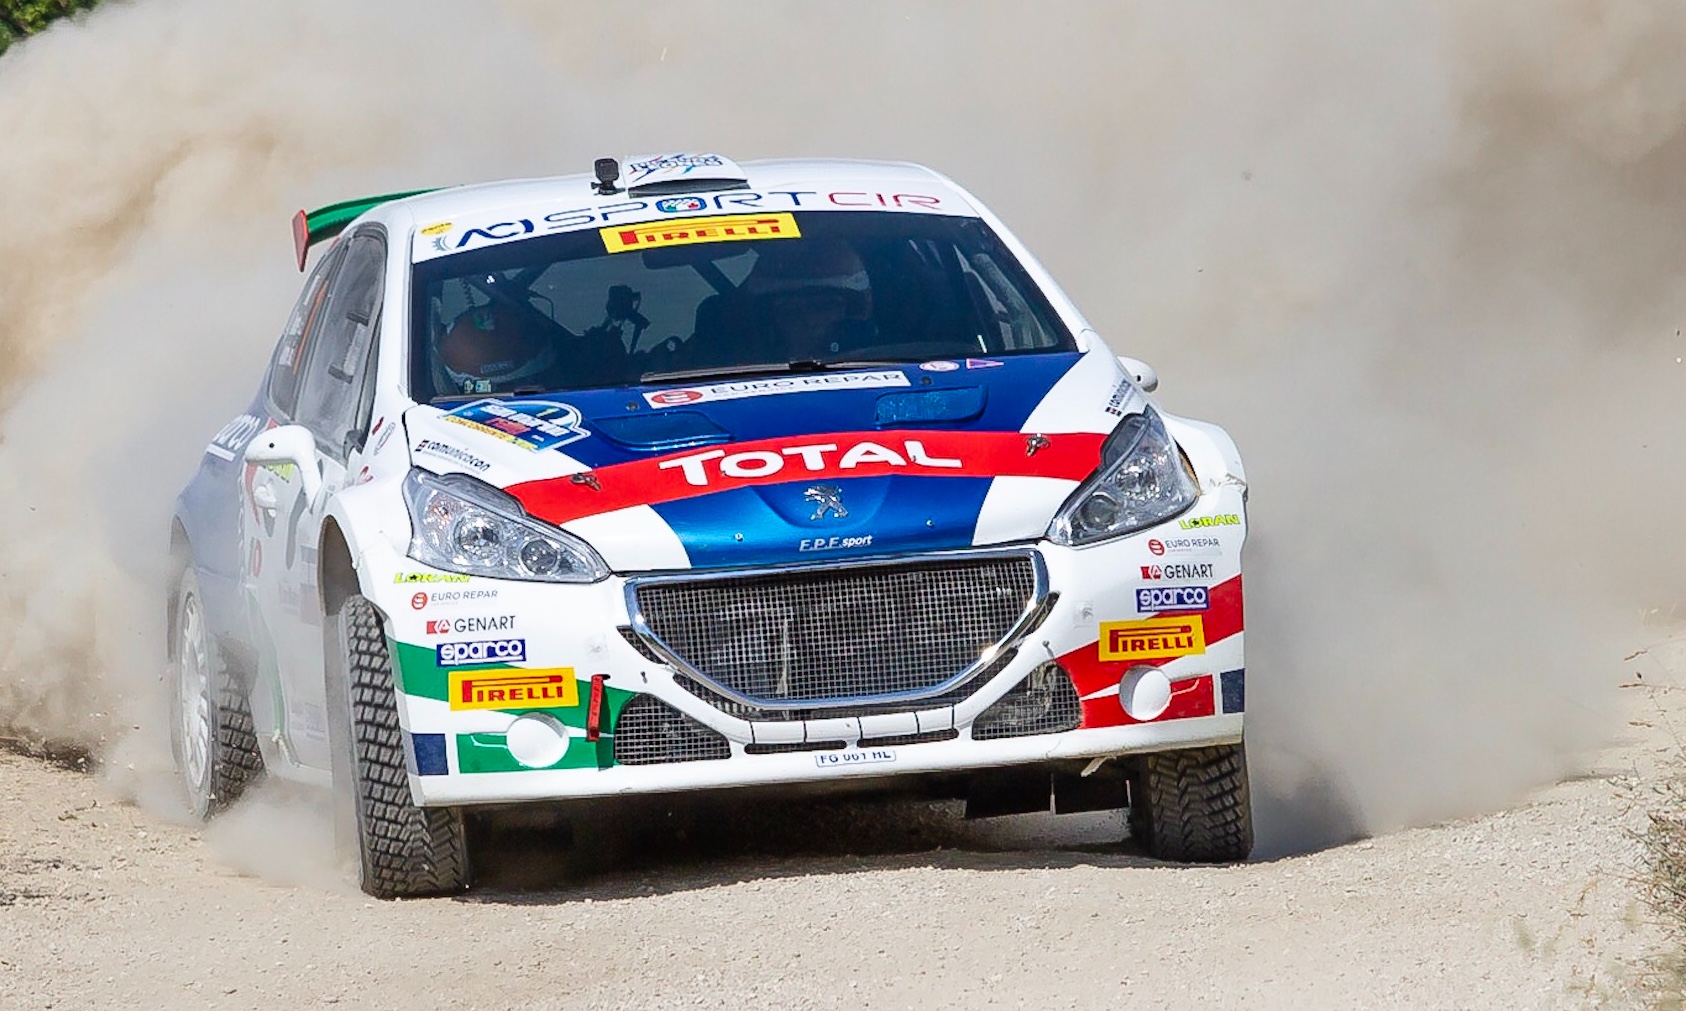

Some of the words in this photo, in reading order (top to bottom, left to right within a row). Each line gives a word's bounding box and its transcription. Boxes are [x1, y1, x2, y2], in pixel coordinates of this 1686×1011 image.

[544, 192, 817, 230] SPORT
[828, 191, 942, 210] CIR
[618, 219, 781, 246] PIRELLI
[711, 380, 795, 395] EURO
[803, 373, 901, 386] REPAR
[658, 440, 963, 487] TOTAL
[1178, 514, 1241, 530] LORAN
[842, 534, 873, 548] sport
[1165, 539, 1191, 548] EURO
[1192, 538, 1220, 547] REPAR
[394, 572, 471, 584] LORAN
[1164, 563, 1214, 580] GENART
[430, 592, 461, 602] EURO
[463, 589, 498, 600] REPAR
[1139, 587, 1207, 611] sparco
[454, 615, 517, 633] GENART
[1110, 625, 1194, 653] PIRELLI
[440, 639, 523, 665] sparco
[462, 674, 563, 702] PIRELLI
